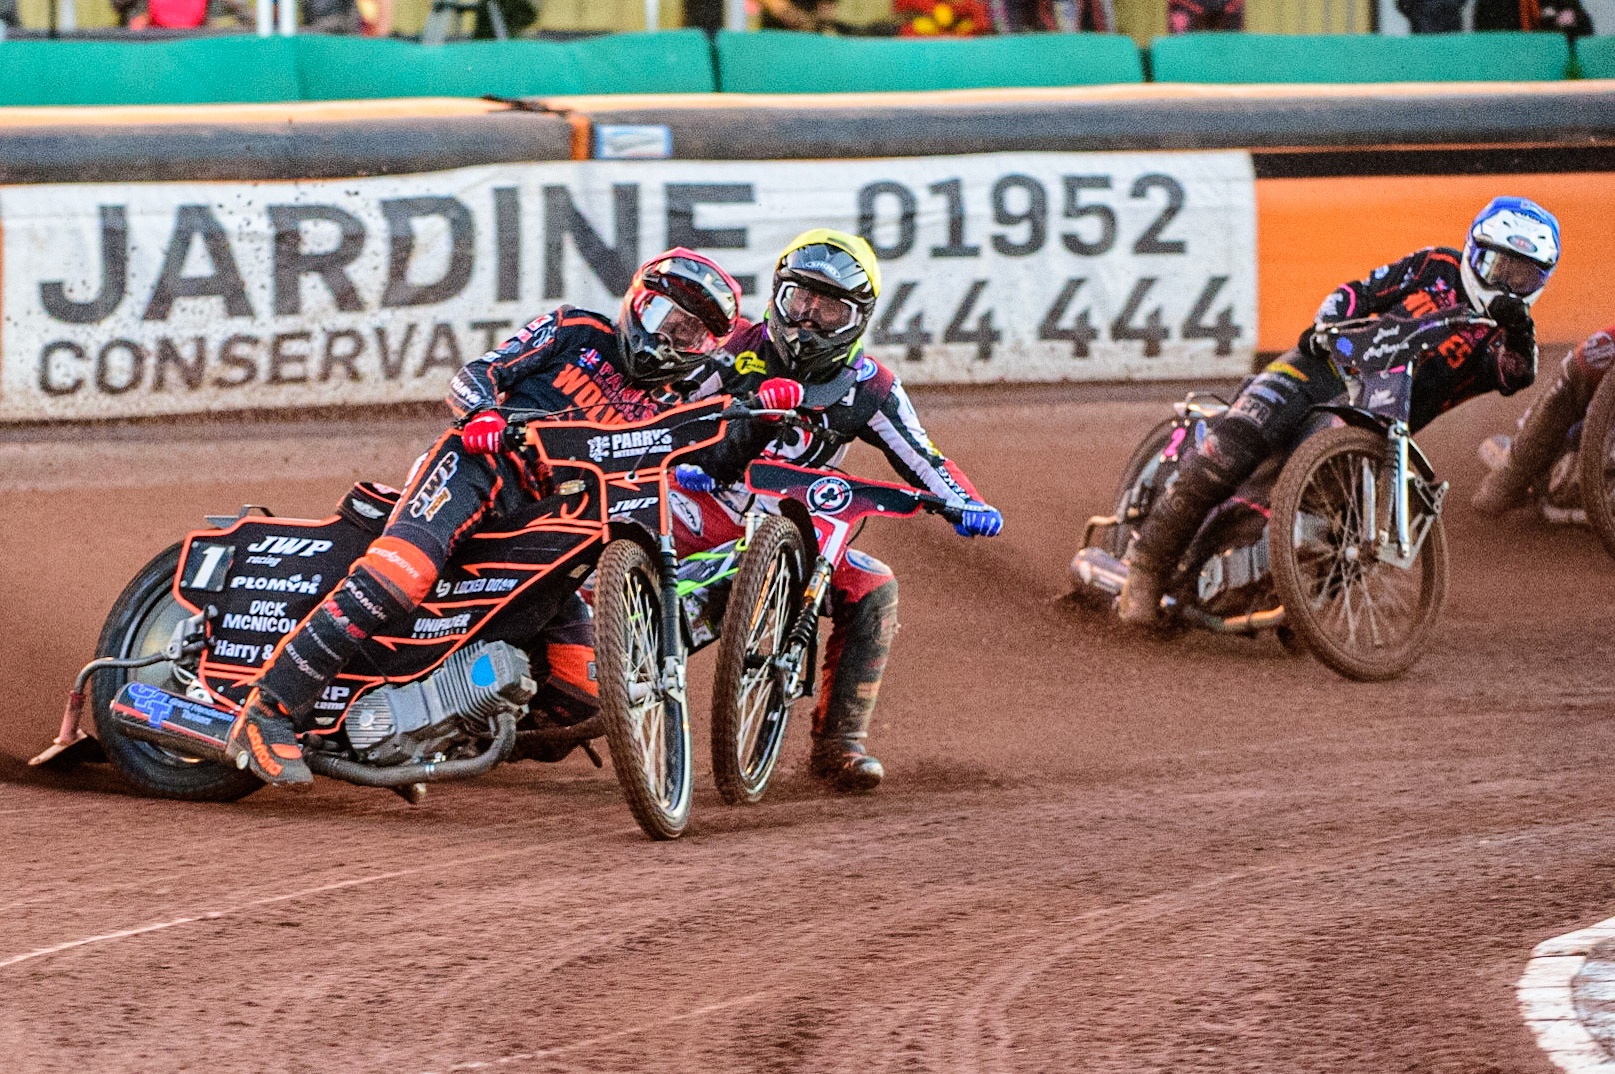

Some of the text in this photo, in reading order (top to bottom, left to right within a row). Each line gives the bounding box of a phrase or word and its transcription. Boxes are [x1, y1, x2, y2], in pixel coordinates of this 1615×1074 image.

[39, 172, 1187, 325] JARDINE 01952
[1039, 274, 1241, 359] 444
[611, 428, 673, 450] PARRYS
[608, 496, 659, 513] JWP
[247, 535, 333, 557] JWP
[191, 546, 226, 589] 1
[246, 555, 282, 567] racing
[249, 600, 287, 616] DICK
[213, 639, 274, 663] Harry &
